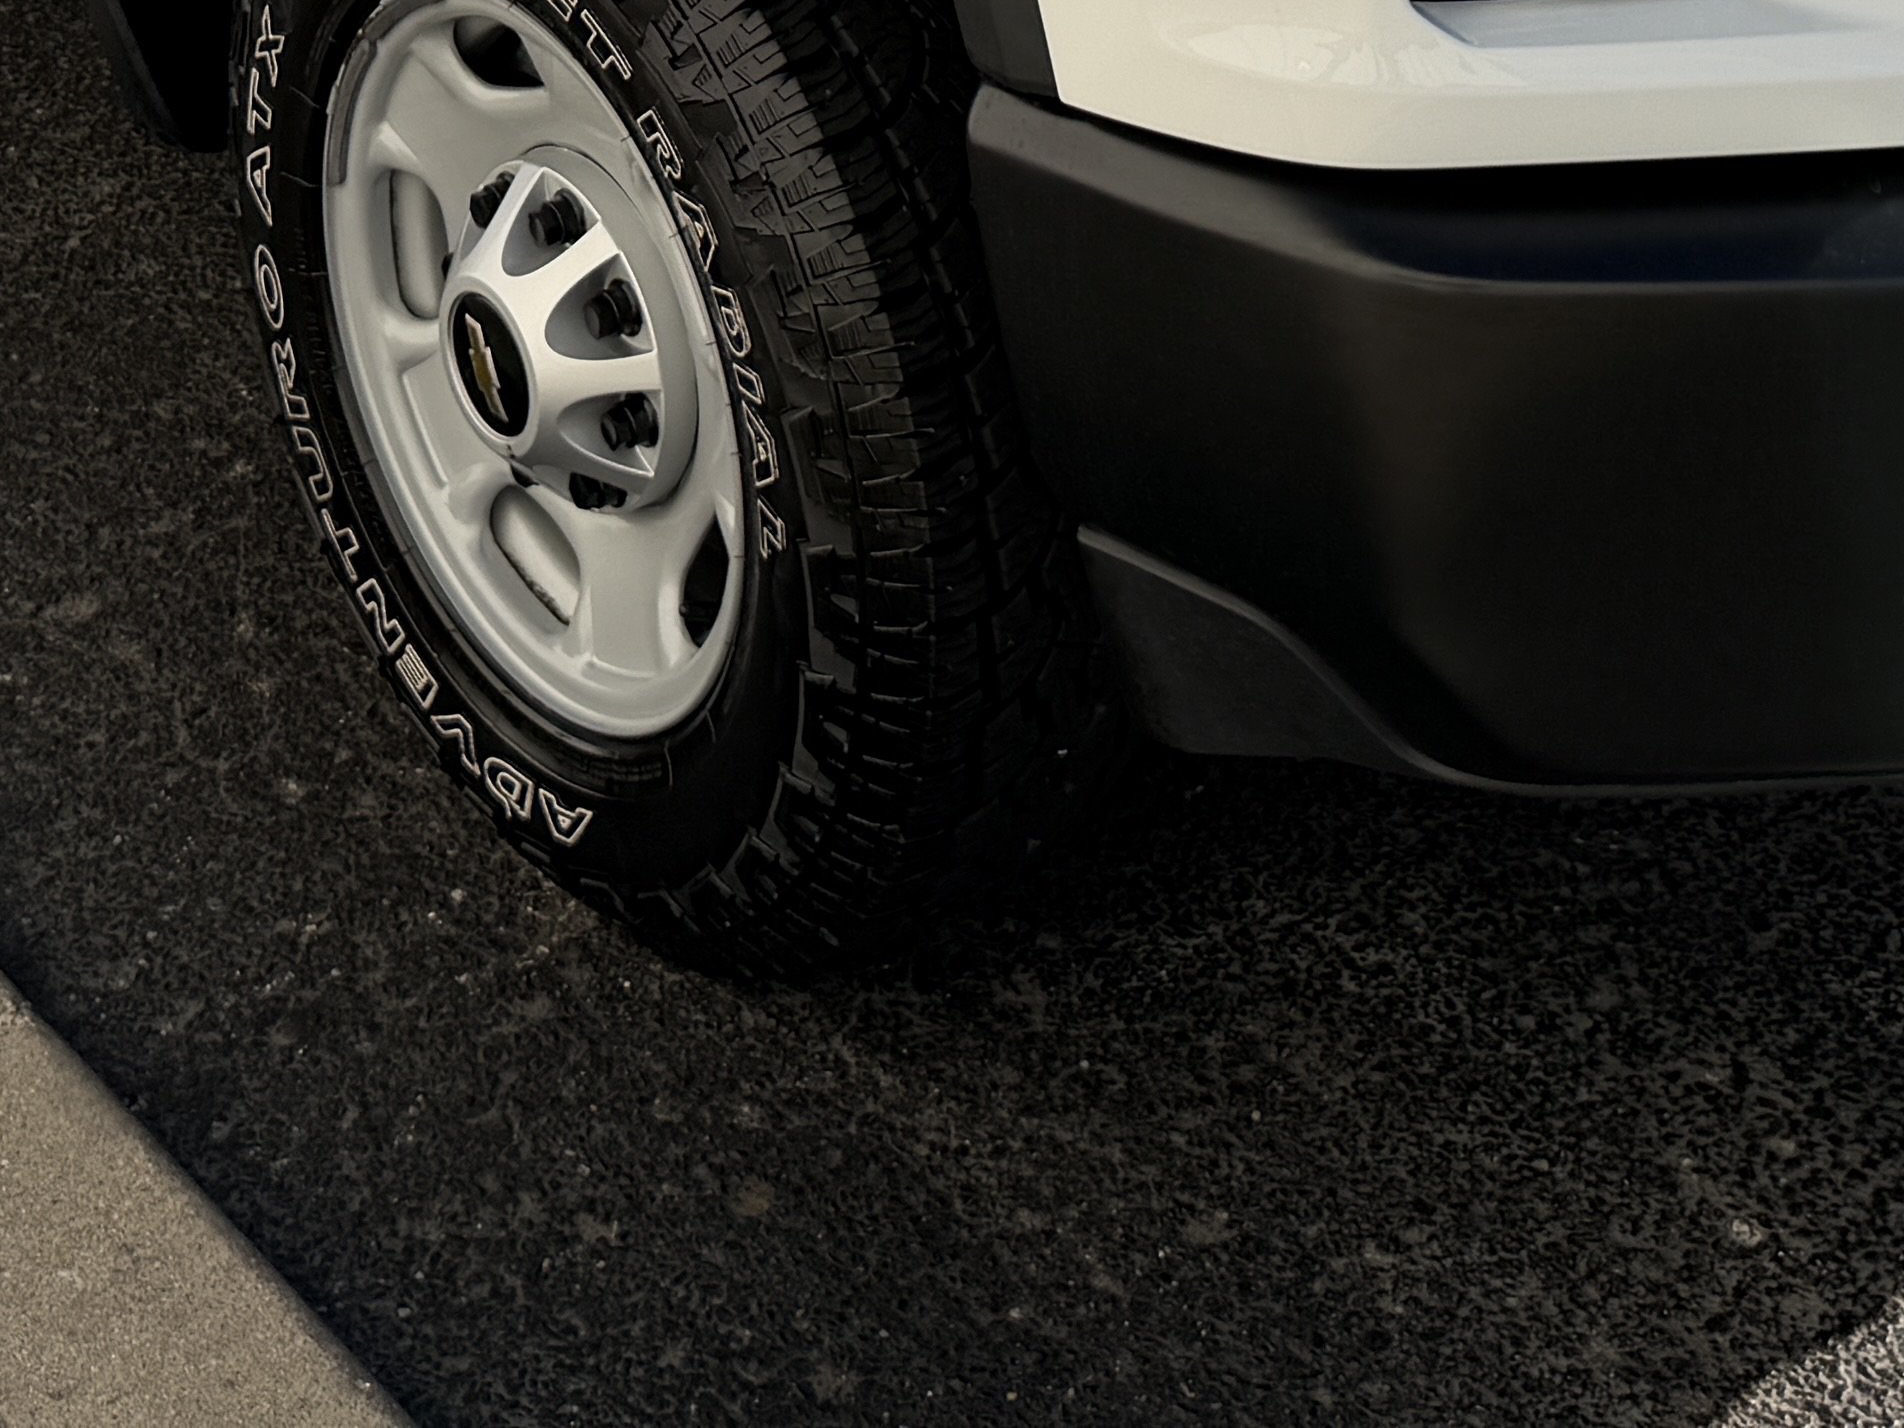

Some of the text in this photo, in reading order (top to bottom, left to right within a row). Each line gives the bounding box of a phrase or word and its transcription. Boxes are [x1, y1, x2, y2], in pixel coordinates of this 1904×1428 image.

[244, 2, 596, 848] ADVENTURO ATX
[636, 105, 788, 560] RADIAL
